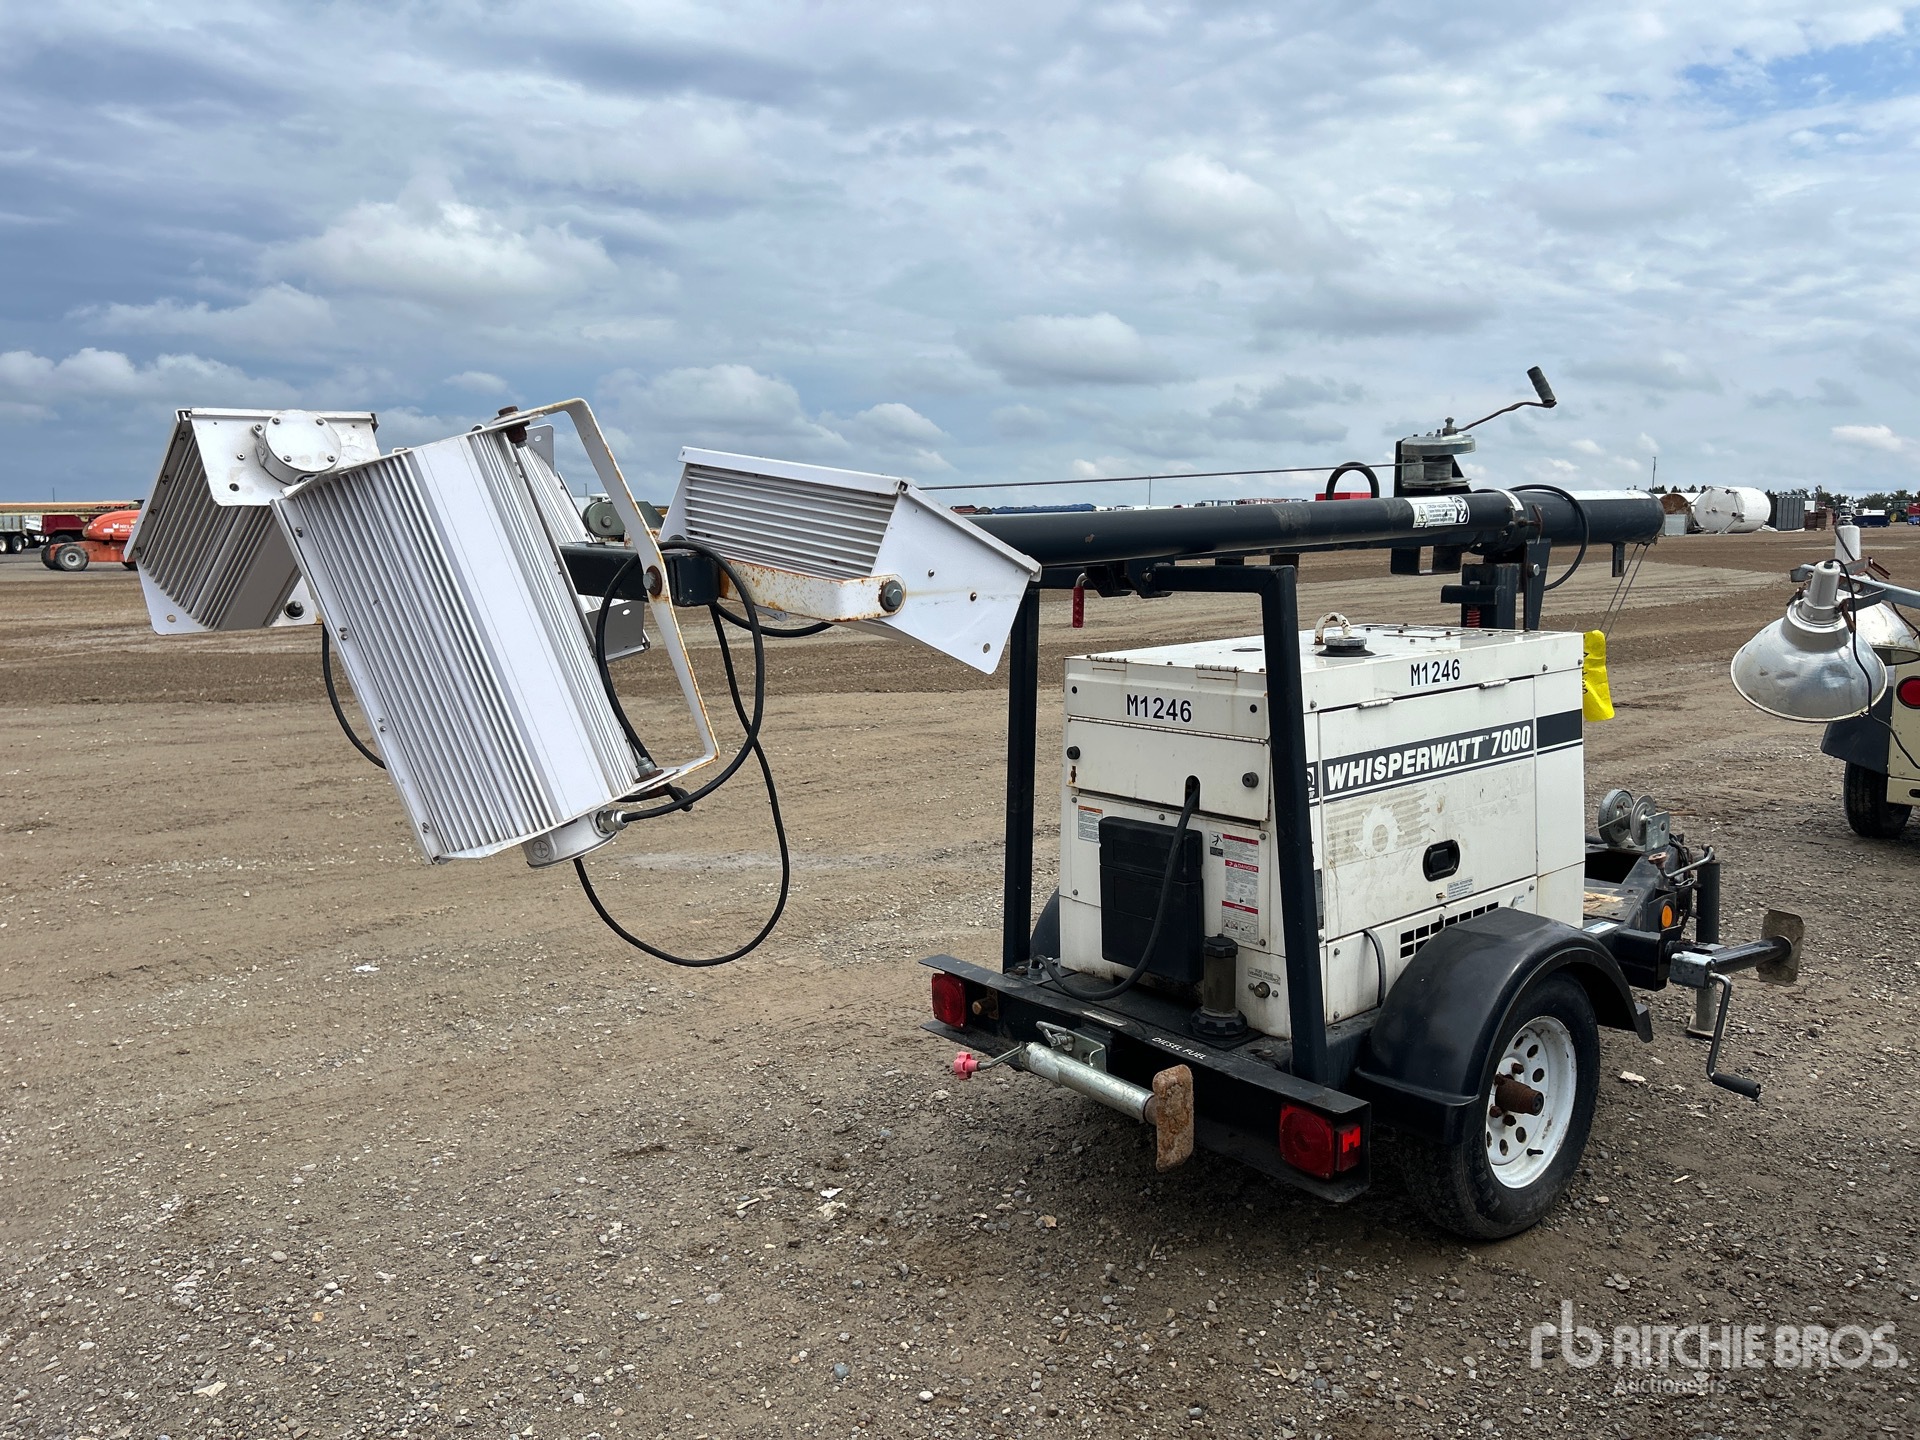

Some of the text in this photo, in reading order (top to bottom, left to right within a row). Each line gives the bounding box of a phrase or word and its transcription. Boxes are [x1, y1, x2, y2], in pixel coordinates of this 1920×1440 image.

[1410, 658, 1461, 687] M1246
[1126, 693, 1192, 724] M1246
[1491, 725, 1532, 756] 7000
[1151, 1037, 1206, 1060] DIESEL FUEL
